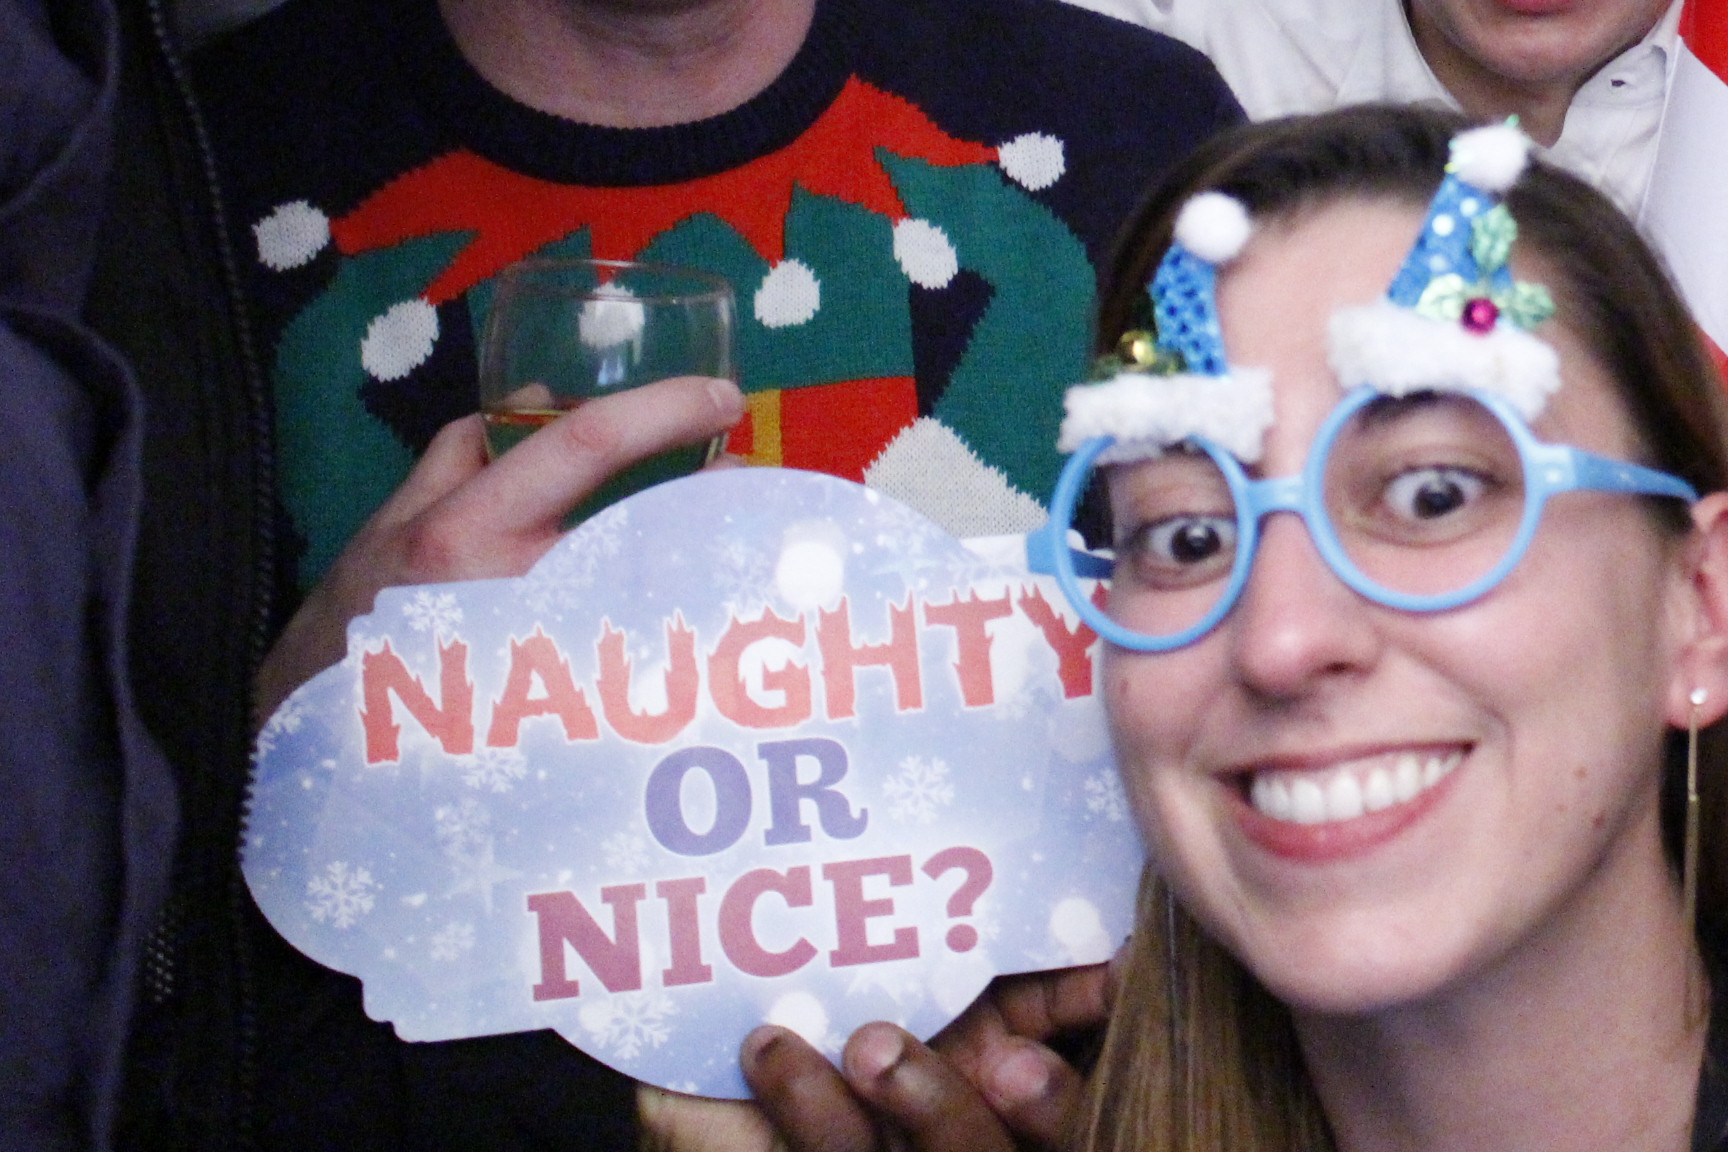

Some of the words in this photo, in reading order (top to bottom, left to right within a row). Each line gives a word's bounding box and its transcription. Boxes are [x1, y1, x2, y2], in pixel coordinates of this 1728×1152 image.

[358, 583, 1111, 765] NAUGHTY
[645, 737, 869, 857] OR
[527, 846, 994, 1003] NICE?
